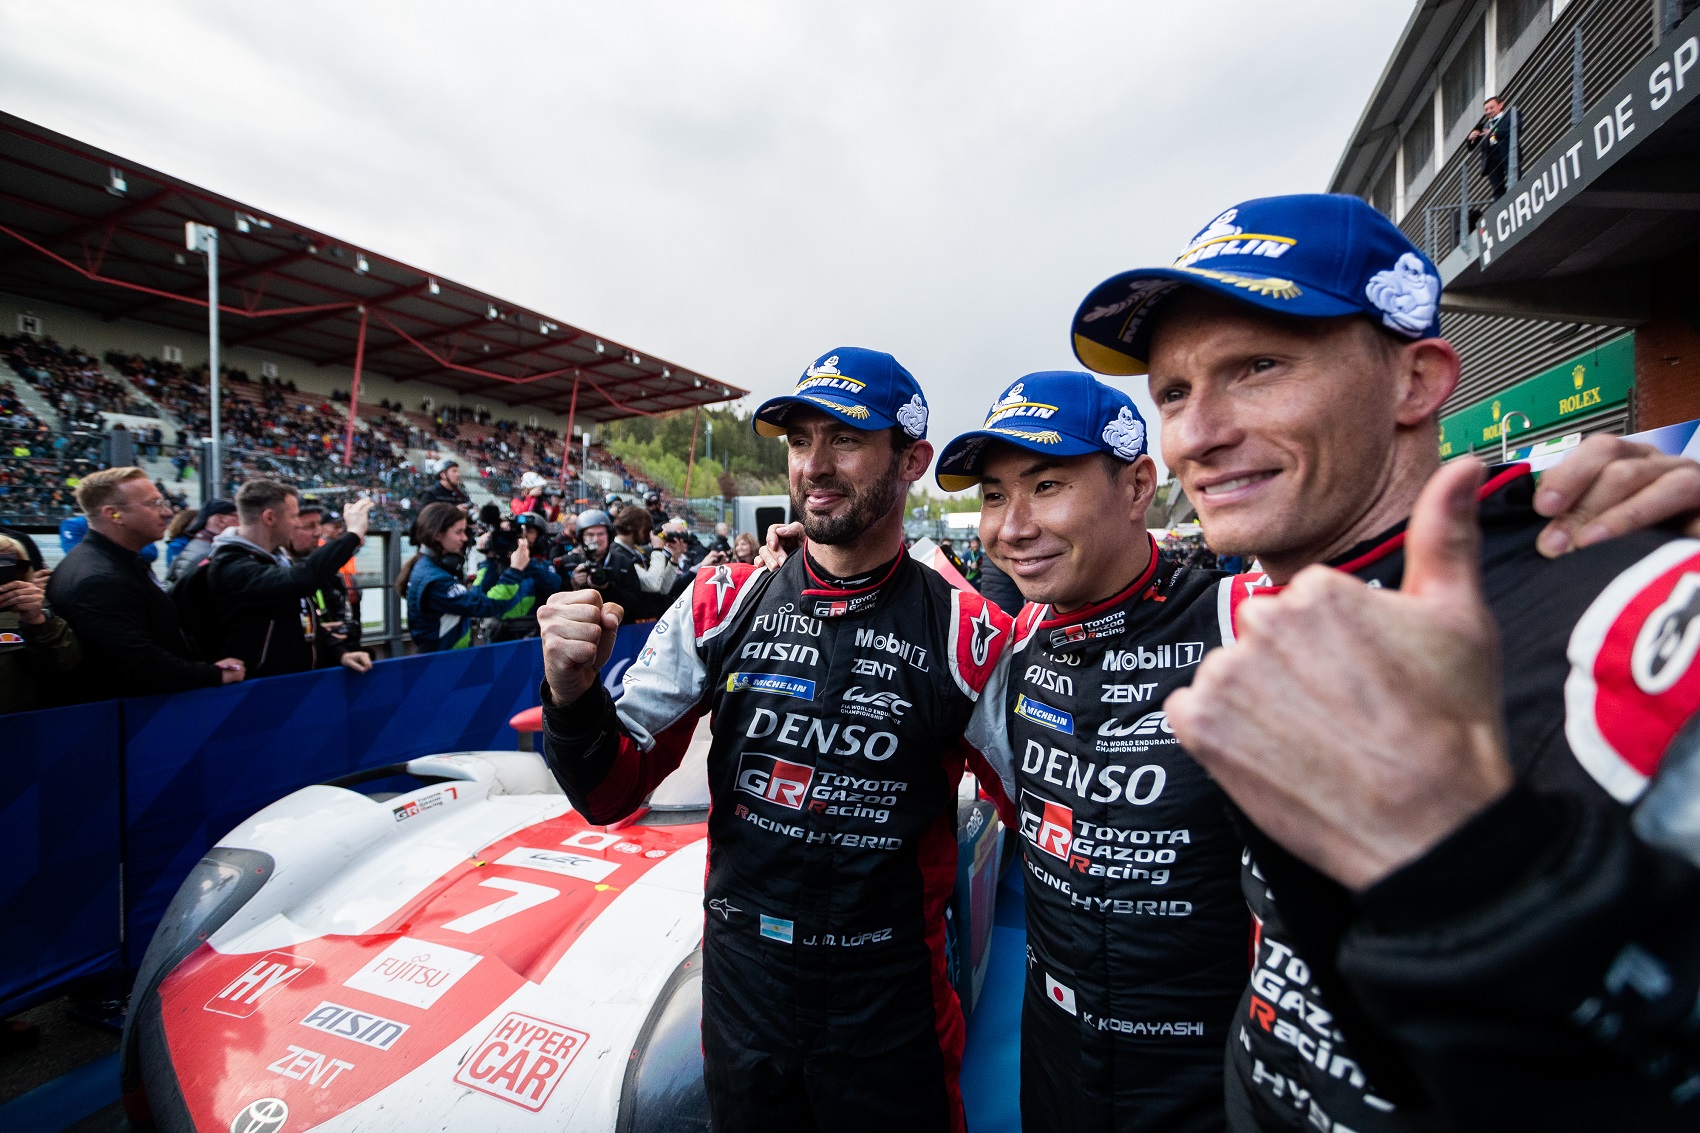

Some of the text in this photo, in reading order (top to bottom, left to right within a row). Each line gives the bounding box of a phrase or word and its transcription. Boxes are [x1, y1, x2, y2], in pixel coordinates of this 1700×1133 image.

[1497, 36, 1699, 242] CIRCUIT DE SP
[22, 317, 37, 332] H
[1559, 387, 1601, 415] ROLEX
[752, 604, 822, 637] FUJITSU
[815, 607, 845, 616] GR
[1085, 611, 1125, 628] TOYOTA
[854, 628, 909, 660] Mobil
[1087, 626, 1125, 639] Racing
[741, 642, 819, 666] AISIN
[1102, 645, 1171, 672] Mobil
[851, 658, 897, 680] ZENT
[1024, 664, 1073, 696] AISIN
[753, 679, 807, 693] MICHELIN
[1101, 682, 1159, 703] ZENT
[843, 686, 912, 715] WEC
[851, 705, 873, 713] WORLD
[841, 709, 884, 721] CHAMPIONSHIP
[1027, 705, 1068, 726] MICHELIN
[746, 708, 899, 761] DENSO
[817, 771, 908, 792] TOYOTA
[1021, 739, 1167, 806] DENSO
[444, 787, 457, 800] 7
[738, 769, 805, 807] GR
[811, 786, 897, 806] GAZOO
[395, 805, 418, 820] GR
[807, 800, 890, 823] Racing
[735, 804, 902, 850] RACING HYBRID
[1020, 811, 1071, 858] GR
[1076, 819, 1191, 844] TOYOTA
[1072, 838, 1176, 864] GAZOO
[1069, 854, 1170, 885] Racing
[440, 876, 560, 934] 7
[1071, 892, 1192, 916] HYBRID
[803, 928, 893, 946] J. M. LÓPEZ
[218, 961, 302, 1004] HY
[372, 954, 450, 988] FUJITSU
[304, 1006, 403, 1046] AISIN
[1083, 1012, 1204, 1036] K. KOBAYASHI
[495, 1018, 578, 1060] HYPER
[266, 1044, 355, 1089] ZENT
[469, 1041, 559, 1102] CAR
